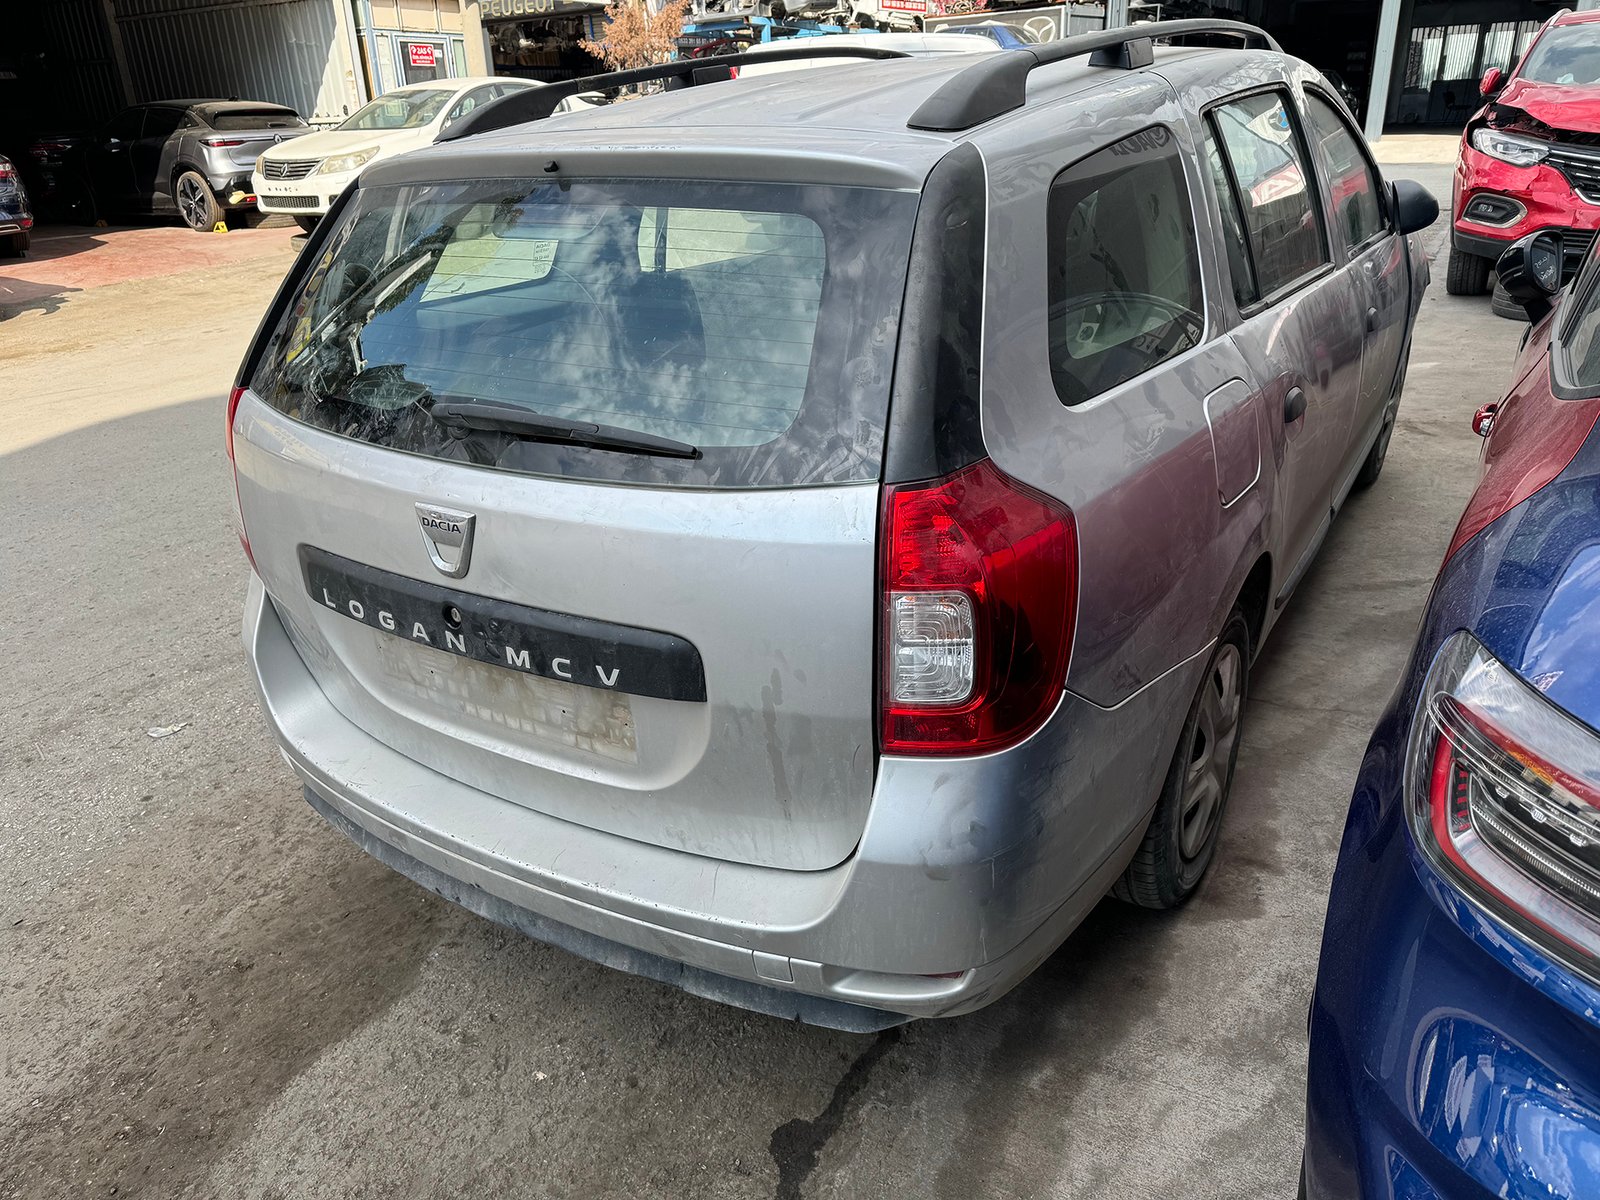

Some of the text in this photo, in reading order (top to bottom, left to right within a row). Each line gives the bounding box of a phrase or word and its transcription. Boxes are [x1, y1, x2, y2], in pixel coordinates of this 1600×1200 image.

[421, 516, 462, 534] DACIA
[322, 587, 620, 687] LOGAN MCV
